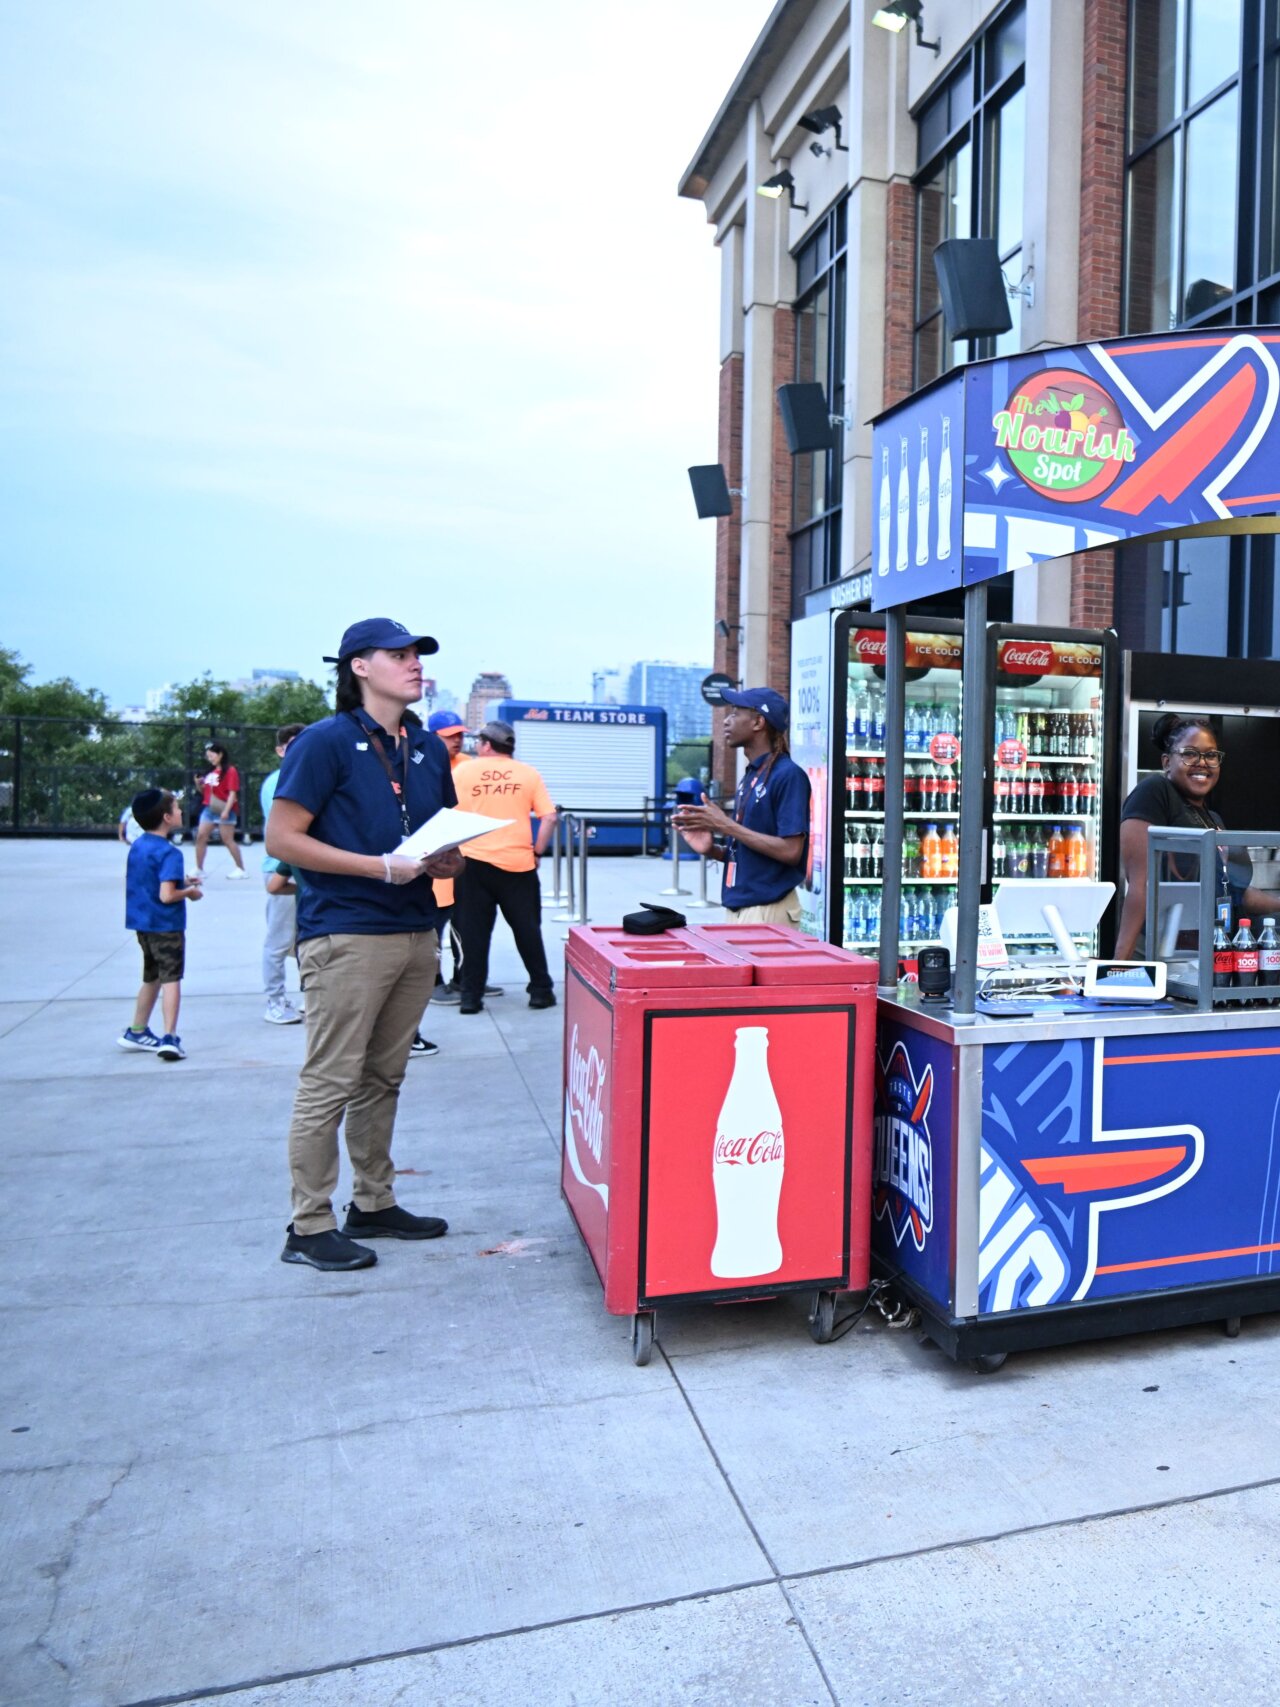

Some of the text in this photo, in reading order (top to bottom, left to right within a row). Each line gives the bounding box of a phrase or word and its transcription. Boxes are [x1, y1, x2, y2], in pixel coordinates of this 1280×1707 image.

[1013, 395, 1045, 416] The
[993, 410, 1136, 462] Nourish
[1033, 454, 1082, 486] Spot
[915, 646, 931, 654] ICE
[935, 648, 960, 656] COLD
[1004, 648, 1051, 666] Coca-Cola
[1077, 657, 1101, 665] COLD
[798, 686, 820, 714] 100%
[553, 709, 595, 722] TEAM
[600, 712, 646, 724] STORE
[480, 770, 513, 782] SDC
[472, 783, 522, 797] STAFF
[568, 1023, 606, 1165] Coca-Cola
[889, 1081, 912, 1103] TASTE
[715, 1130, 784, 1166] Coca-Cola
[872, 1115, 930, 1222] QUEENS
